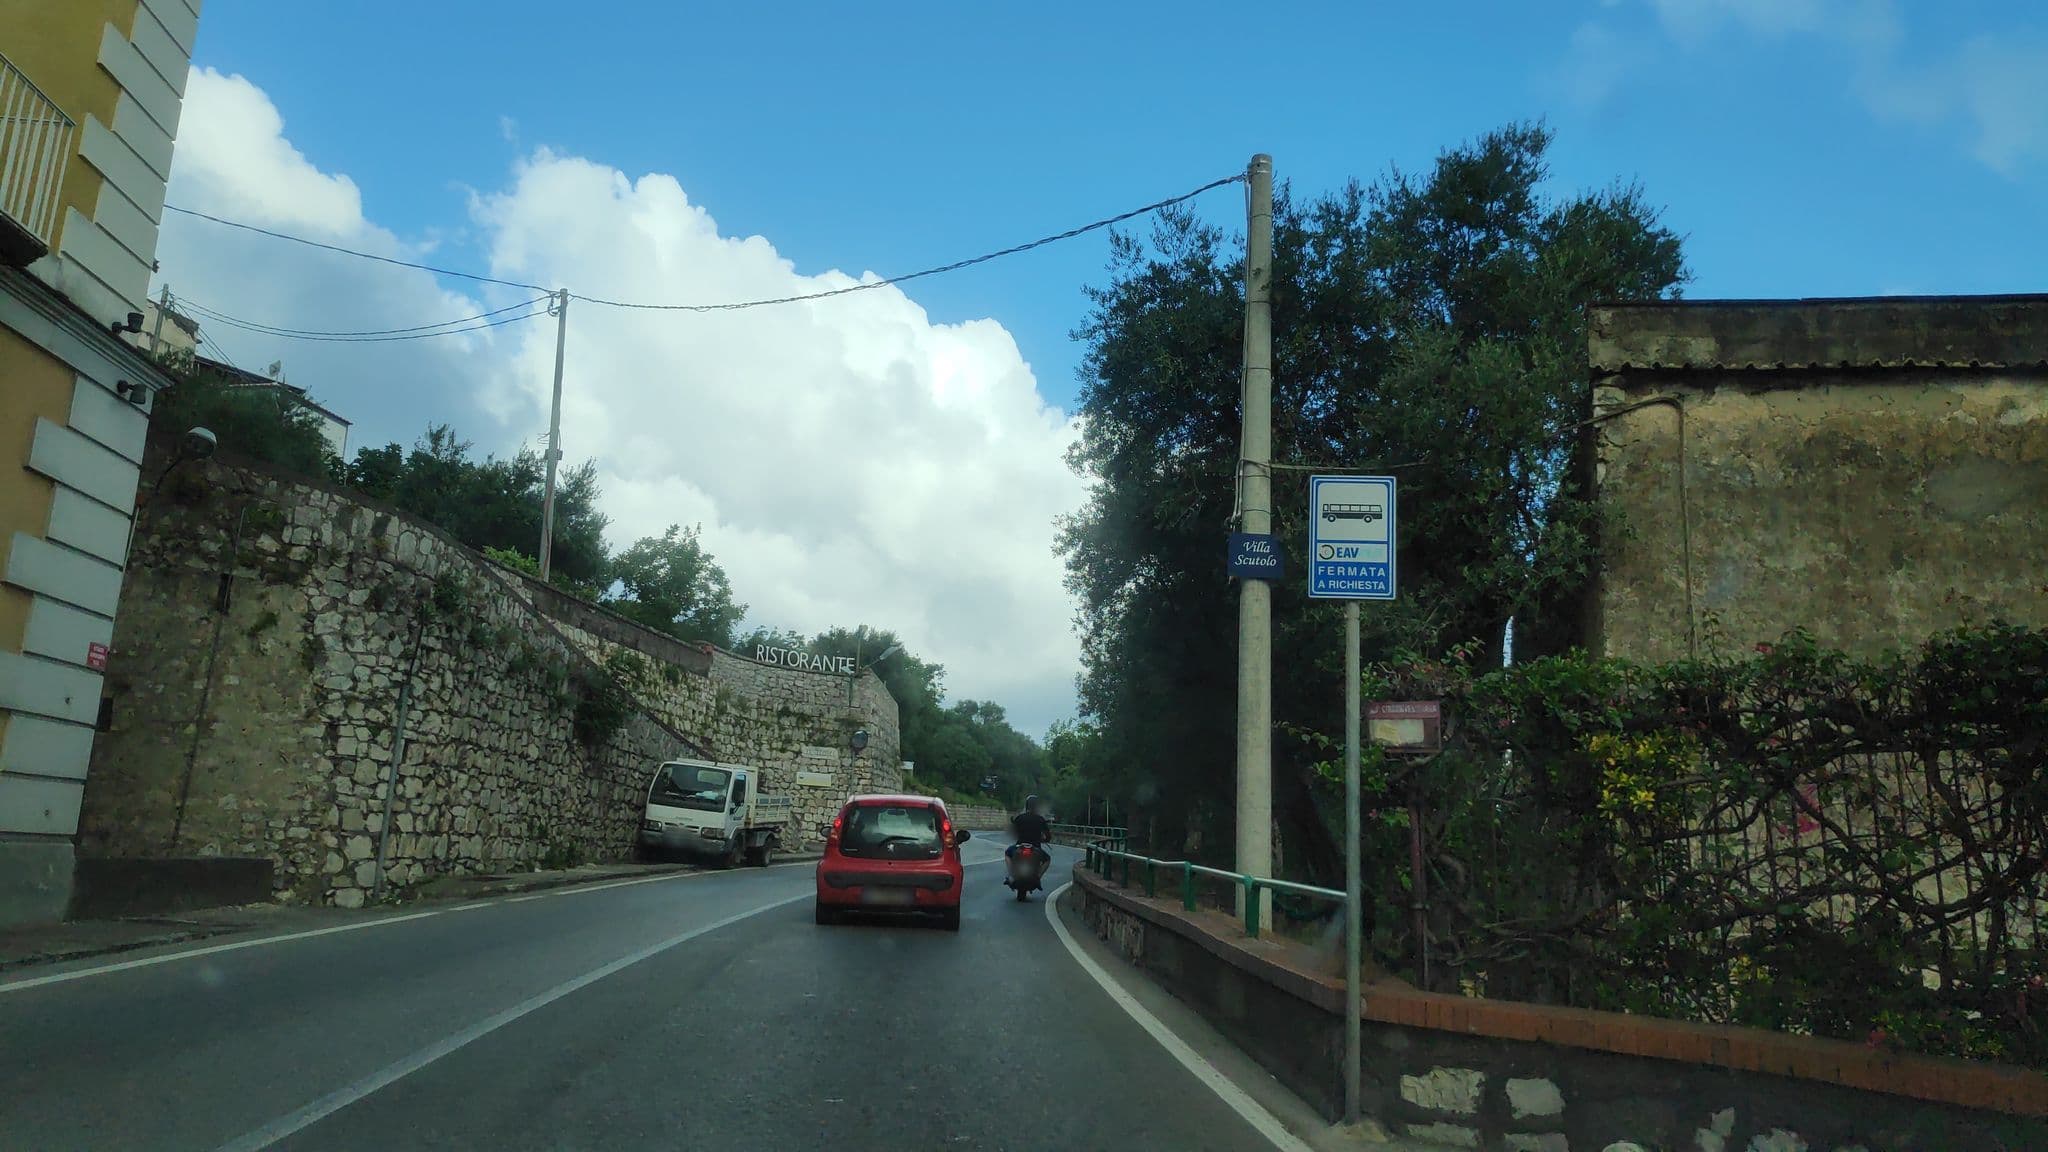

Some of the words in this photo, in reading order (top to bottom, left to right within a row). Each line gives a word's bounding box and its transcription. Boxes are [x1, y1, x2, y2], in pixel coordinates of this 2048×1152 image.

[1243, 540, 1271, 553] Villa
[1336, 547, 1360, 559] EAV
[1234, 554, 1277, 567] Scutolo
[1318, 566, 1386, 577] FERMATA
[1317, 580, 1326, 589] A
[1328, 580, 1386, 590] RICHIESTA
[756, 644, 856, 674] RISTORANTE
